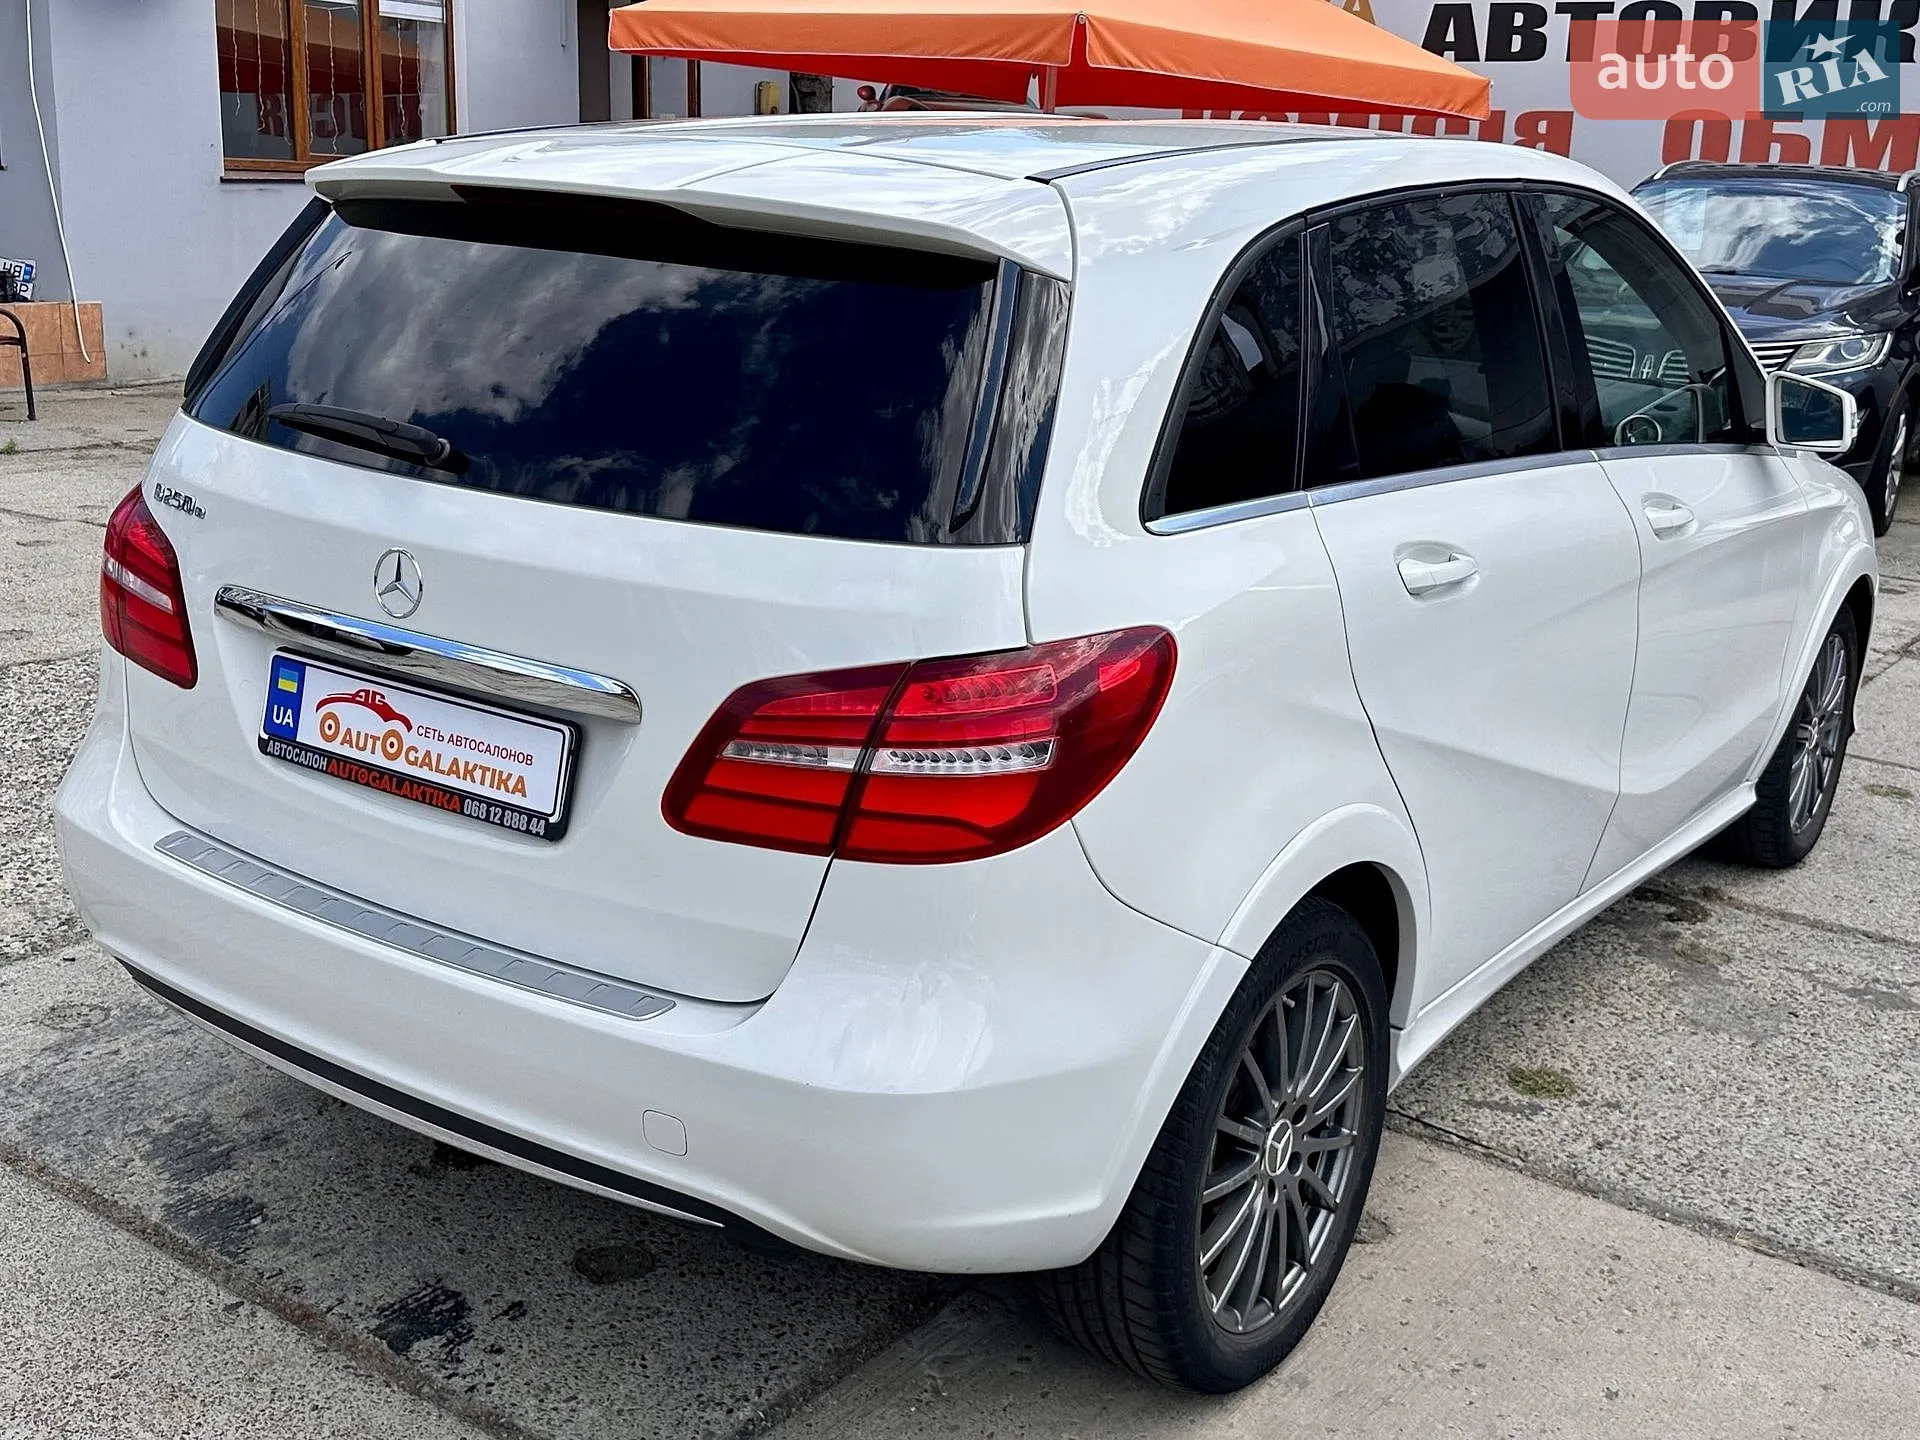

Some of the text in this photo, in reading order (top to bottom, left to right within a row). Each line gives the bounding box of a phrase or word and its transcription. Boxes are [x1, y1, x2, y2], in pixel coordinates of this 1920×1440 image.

[272, 704, 294, 728] UA
[266, 740, 328, 771] АВТОСАЛОН
[416, 725, 534, 766] СЕТЬ АВТОСАЛОНОВ
[327, 758, 546, 836] AUTOGALAKTIKA 068 12 888 44
